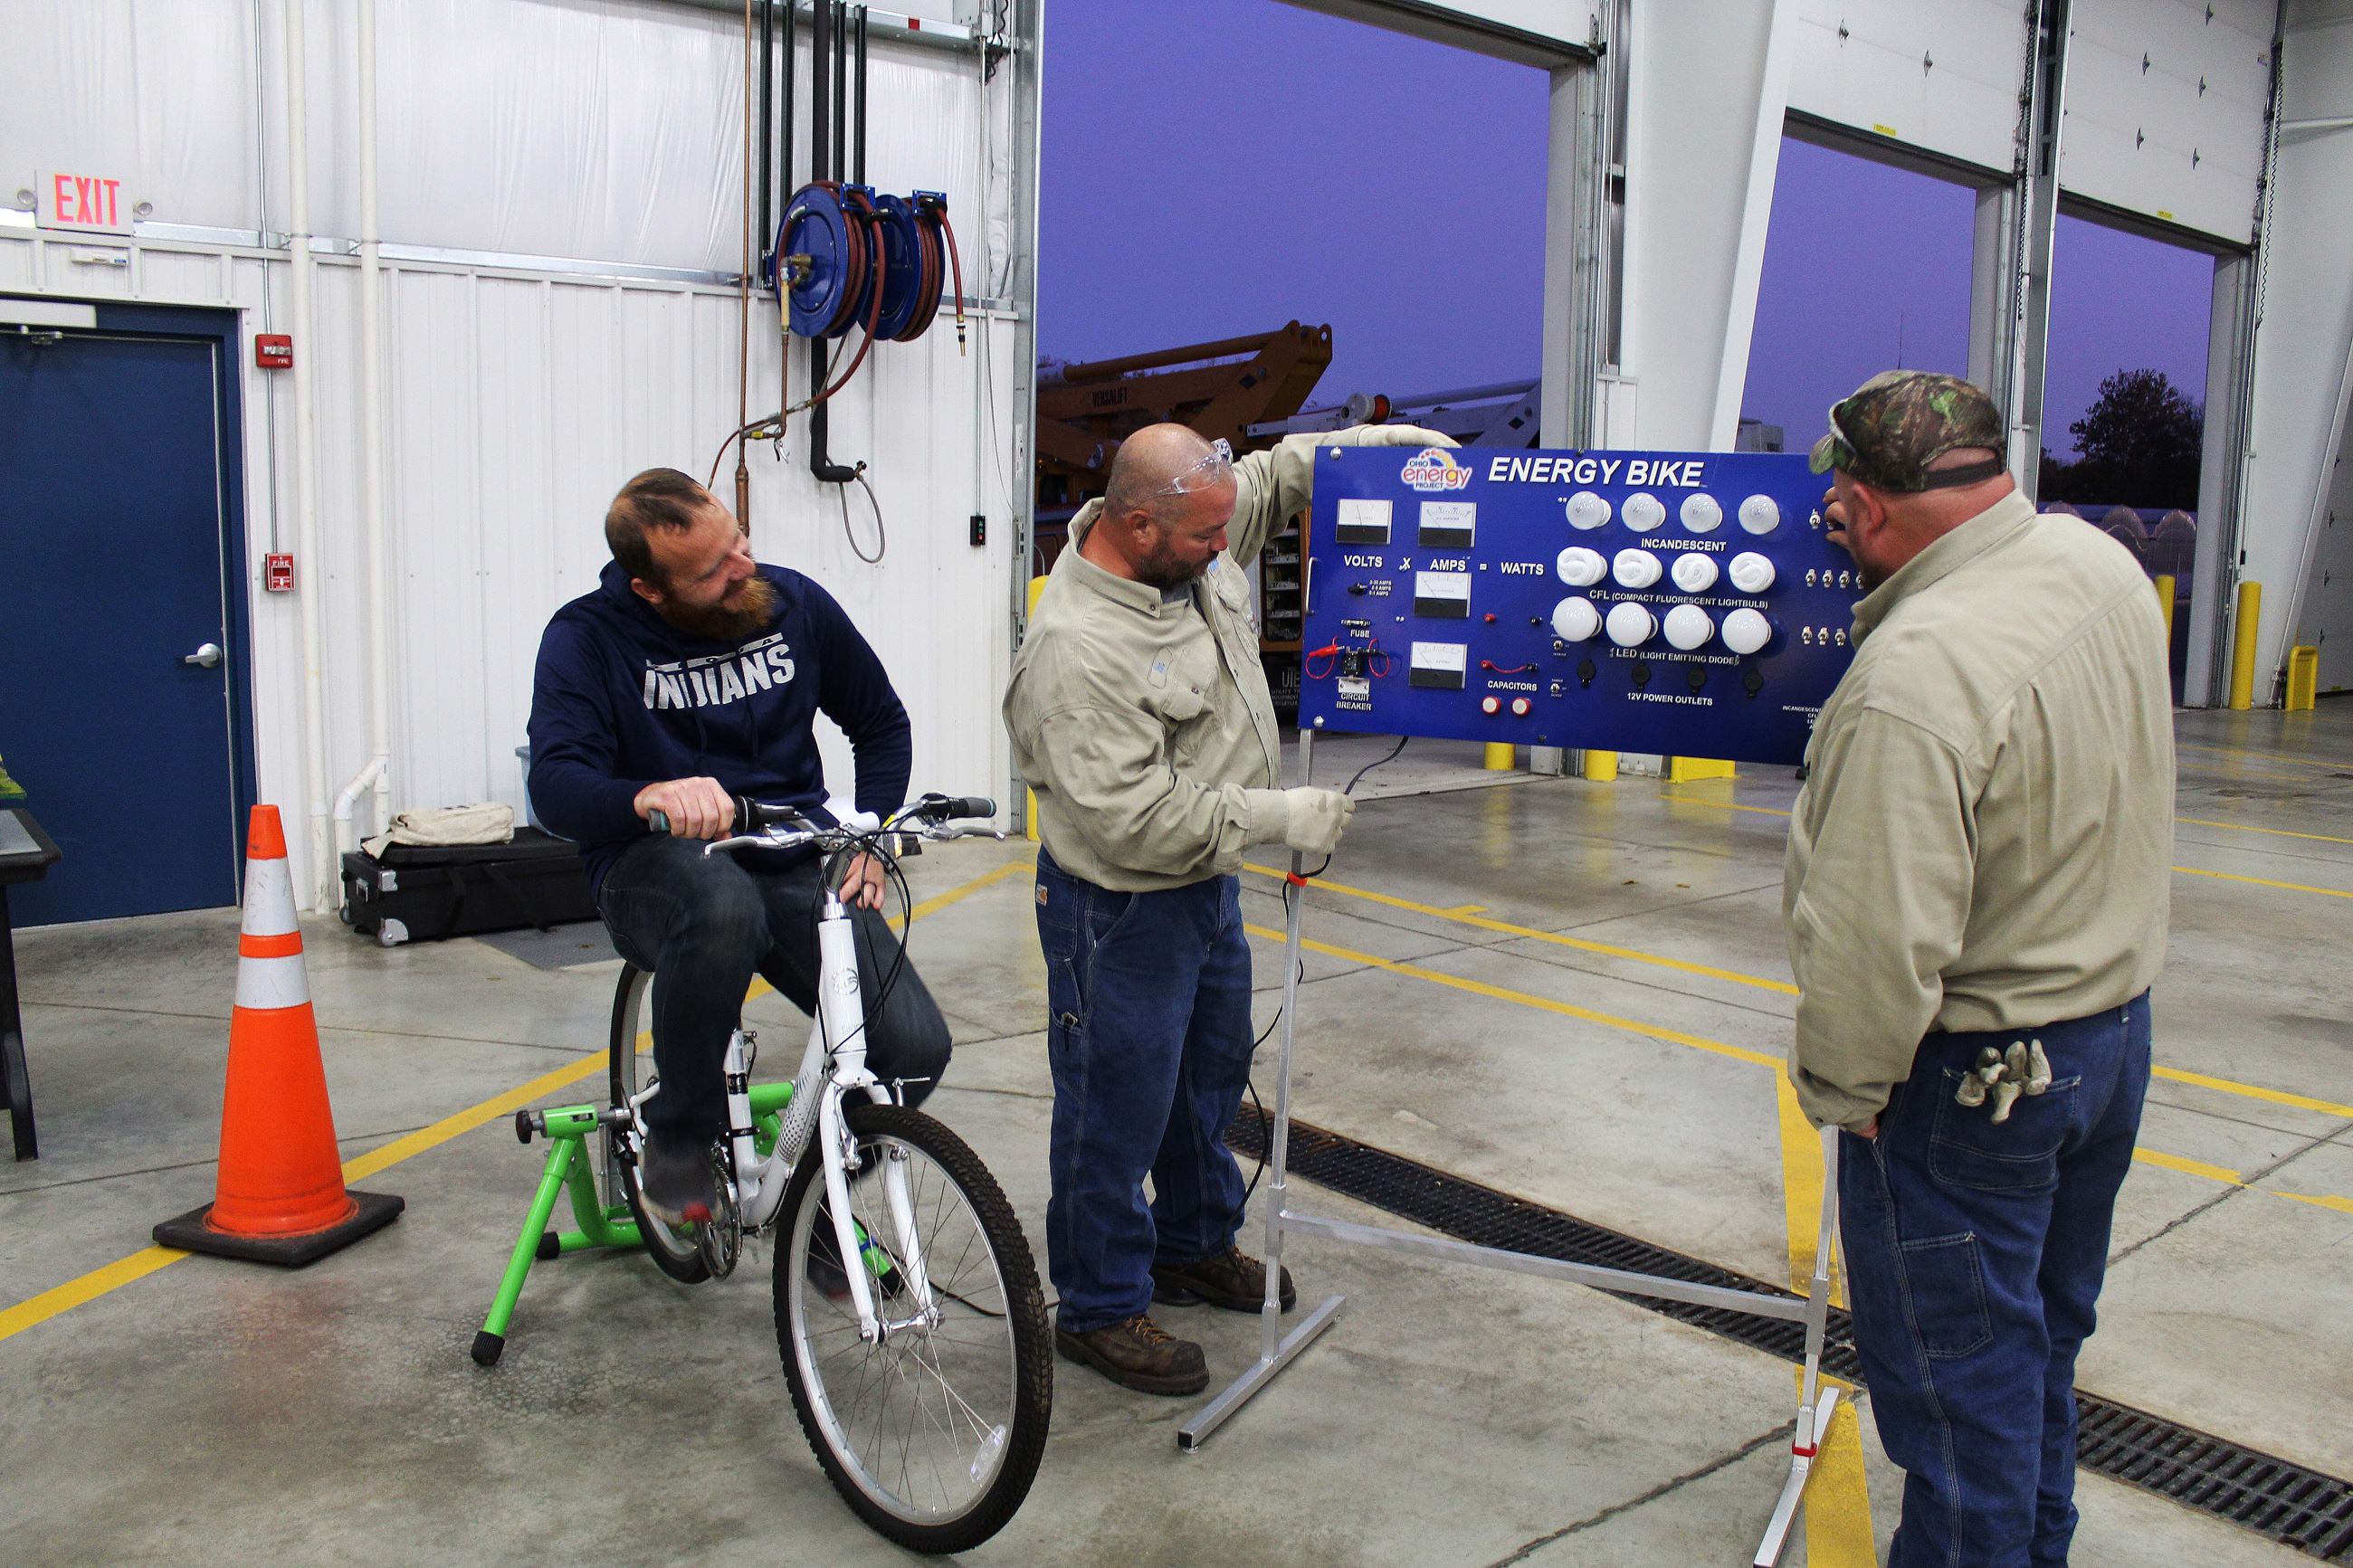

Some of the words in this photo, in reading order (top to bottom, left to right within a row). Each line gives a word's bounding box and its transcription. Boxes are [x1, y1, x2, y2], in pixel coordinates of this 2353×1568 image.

[55, 174, 120, 226] EXIT
[1409, 460, 1429, 468] OHIO
[1404, 468, 1471, 488] energy
[1488, 456, 1622, 485] ENERGY
[1625, 460, 1705, 488] BIKE
[1641, 537, 1727, 552] INCANDESCENT
[1344, 555, 1383, 568] VOLTS
[1430, 558, 1466, 571] AMPS
[1500, 562, 1545, 575] WATTS
[1589, 589, 1609, 600] CFL
[1612, 592, 1653, 603] (COMPACT
[1656, 594, 1717, 606] FLUORESCENT
[1718, 598, 1768, 610] LIGHTBULB)
[1350, 629, 1370, 639] FUSE
[1616, 648, 1637, 659] LED
[1640, 651, 1666, 660] (LIGHT
[1668, 652, 1707, 663] EMITTING
[643, 643, 795, 710] INDIANS
[1487, 680, 1538, 692] CAPACITORS
[1340, 693, 1370, 702] CIRCUIT
[1627, 692, 1642, 701] 12V
[1643, 694, 1673, 704] POWER
[1675, 695, 1713, 707] OUTLETS
[1336, 701, 1372, 711] BREAKER
